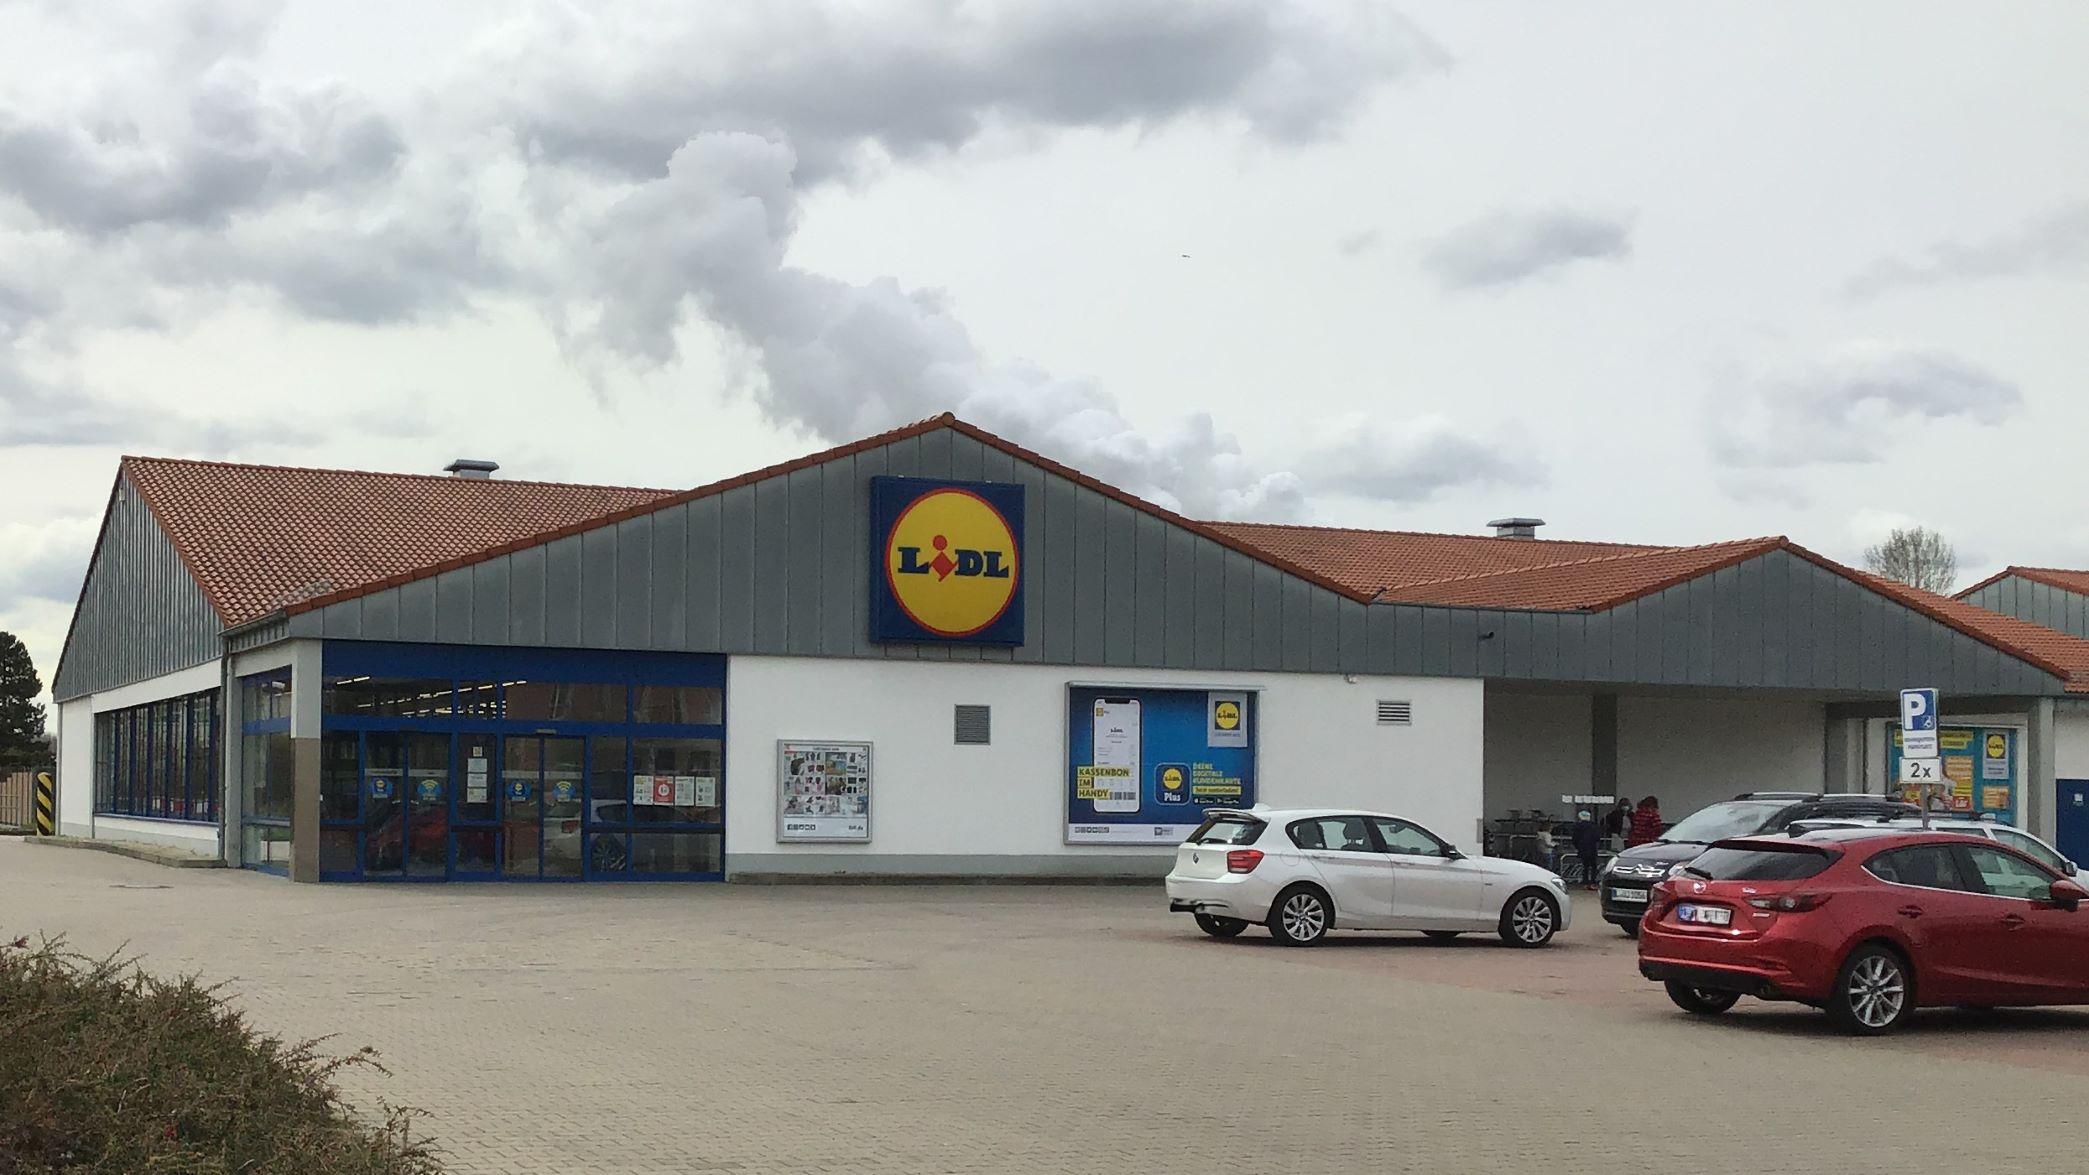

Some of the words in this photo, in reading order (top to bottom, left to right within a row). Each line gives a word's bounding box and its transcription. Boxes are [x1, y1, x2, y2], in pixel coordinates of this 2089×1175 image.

[1903, 693, 1927, 730] P
[1078, 768, 1130, 777] KASSENBON
[1078, 789, 1109, 798] HANDY
[1164, 792, 1181, 802] Plus
